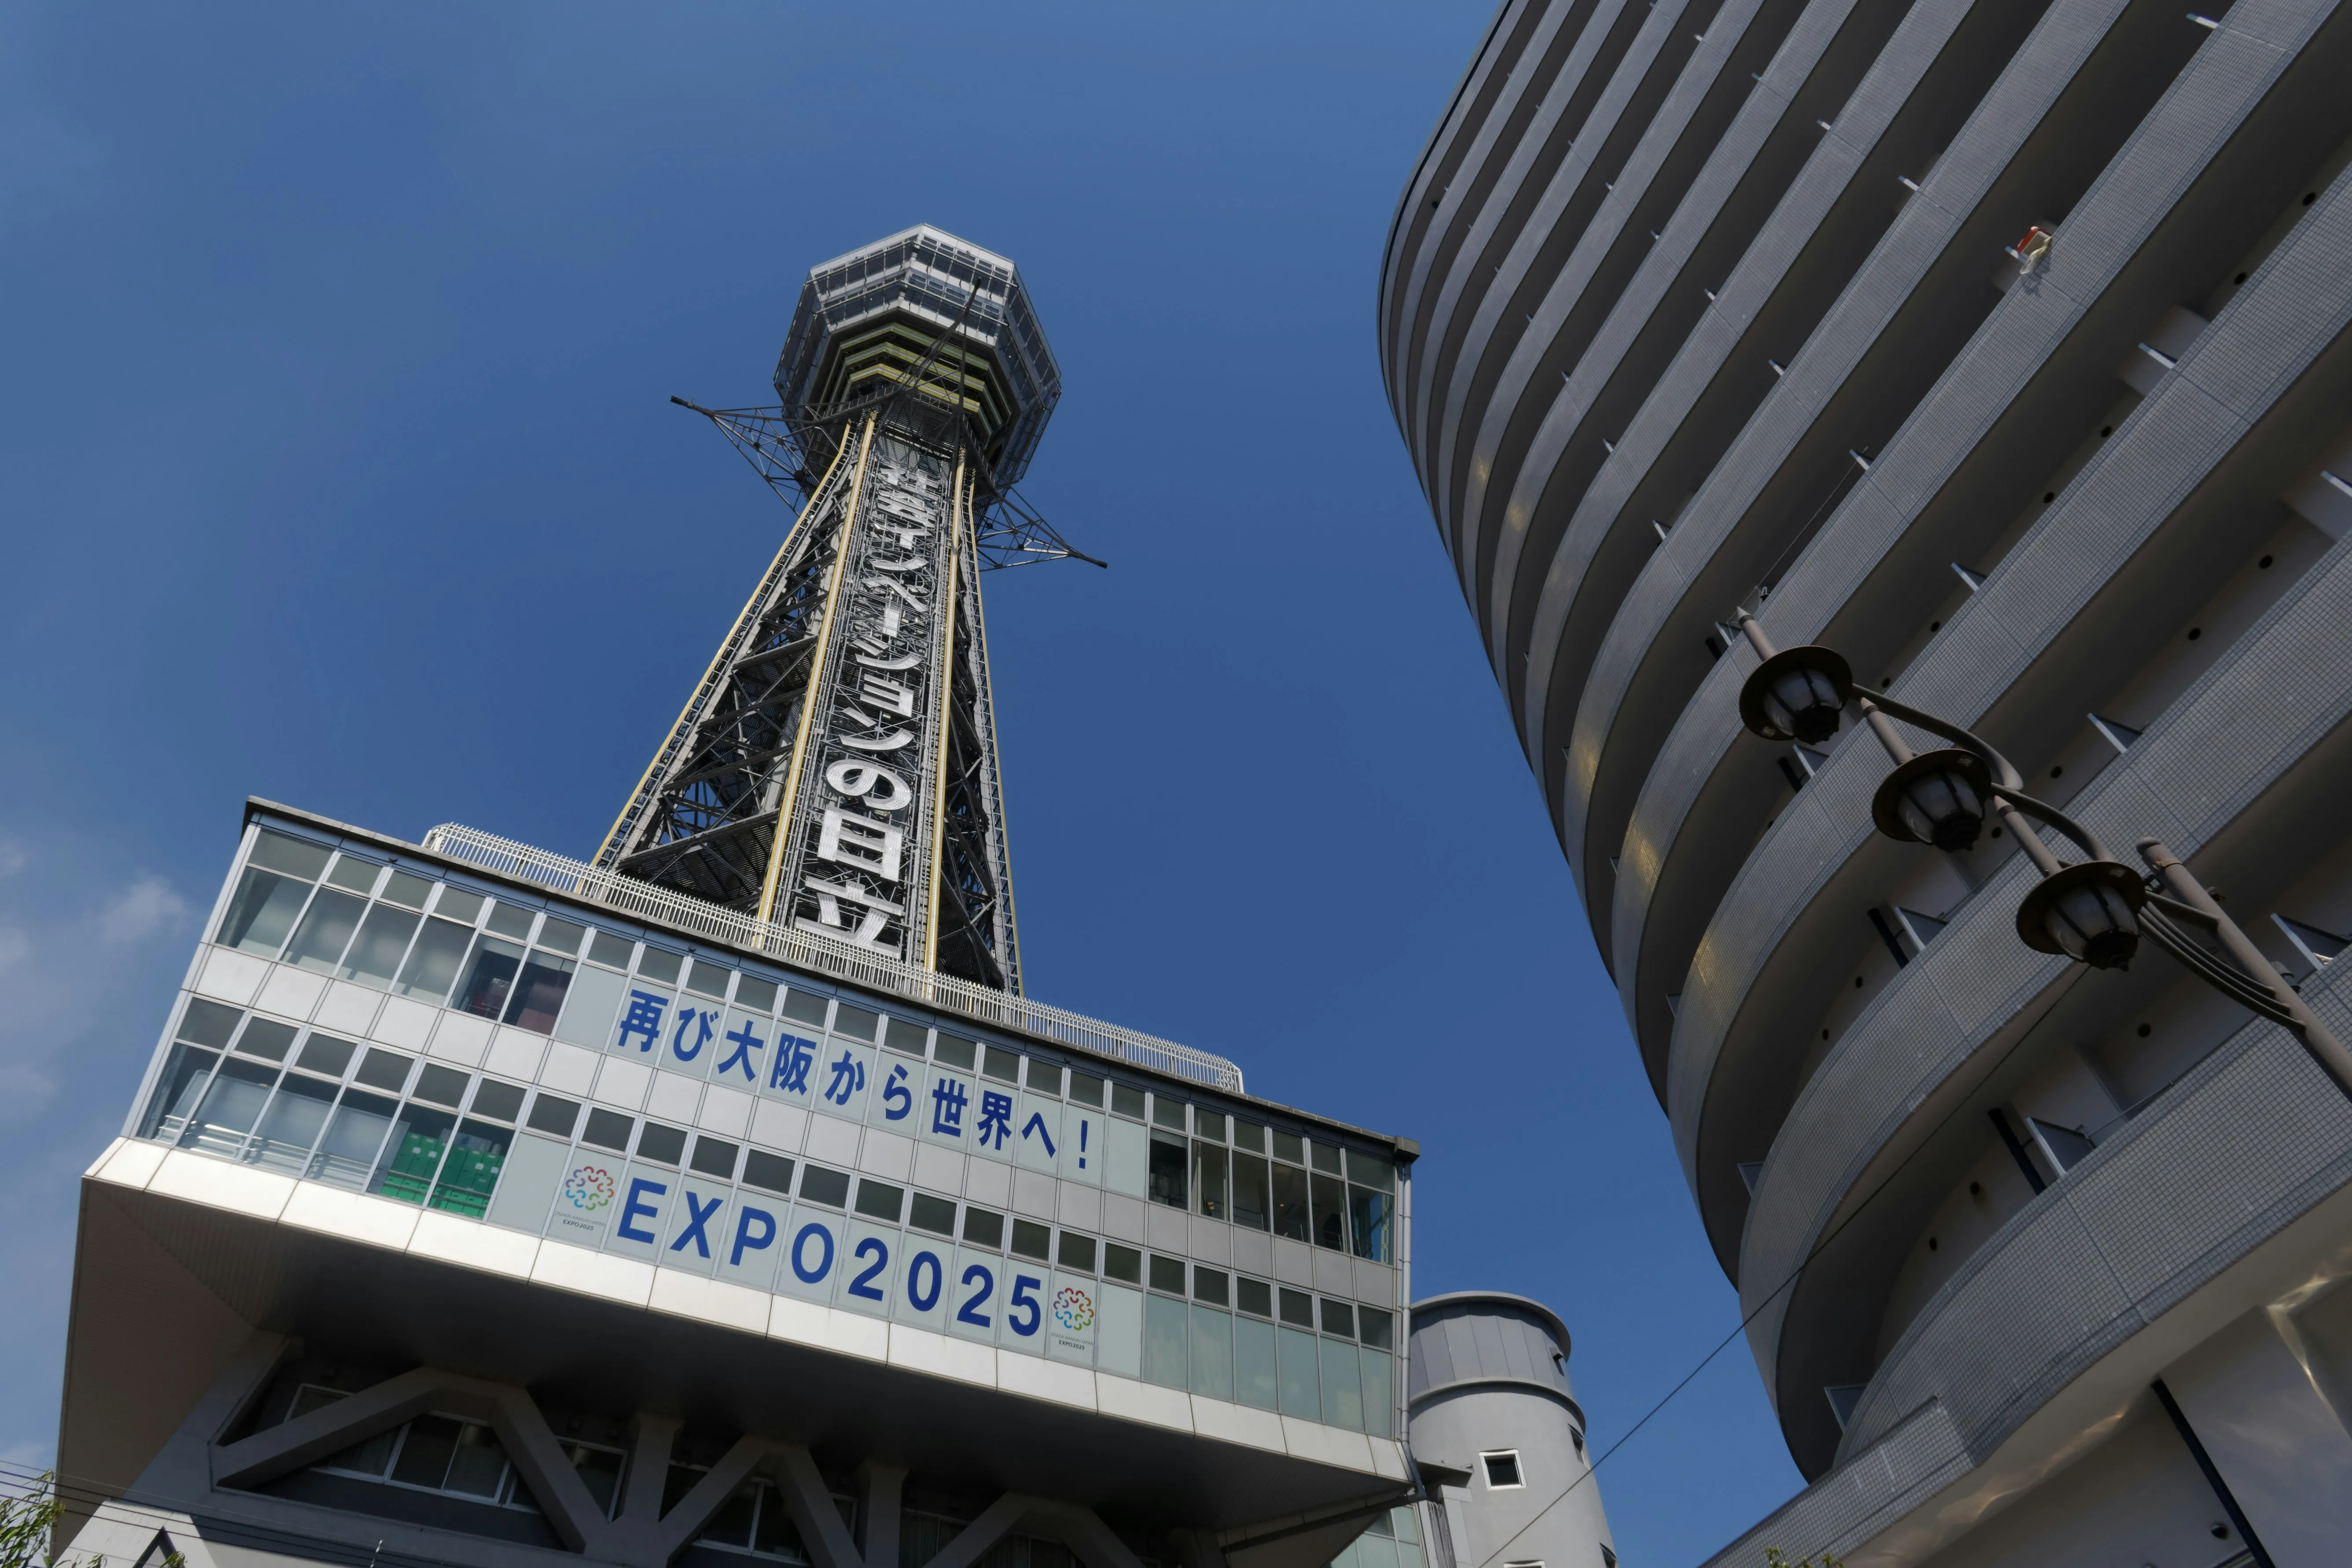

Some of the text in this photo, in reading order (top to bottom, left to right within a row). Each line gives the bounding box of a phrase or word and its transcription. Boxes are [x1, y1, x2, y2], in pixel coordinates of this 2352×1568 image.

[617, 989, 1088, 1170] 再び大阪から世界へ！
[563, 1219, 594, 1231] EXPO2025
[617, 1177, 1041, 1336] EXPO2025
[1058, 1339, 1085, 1350] EXPO2025
